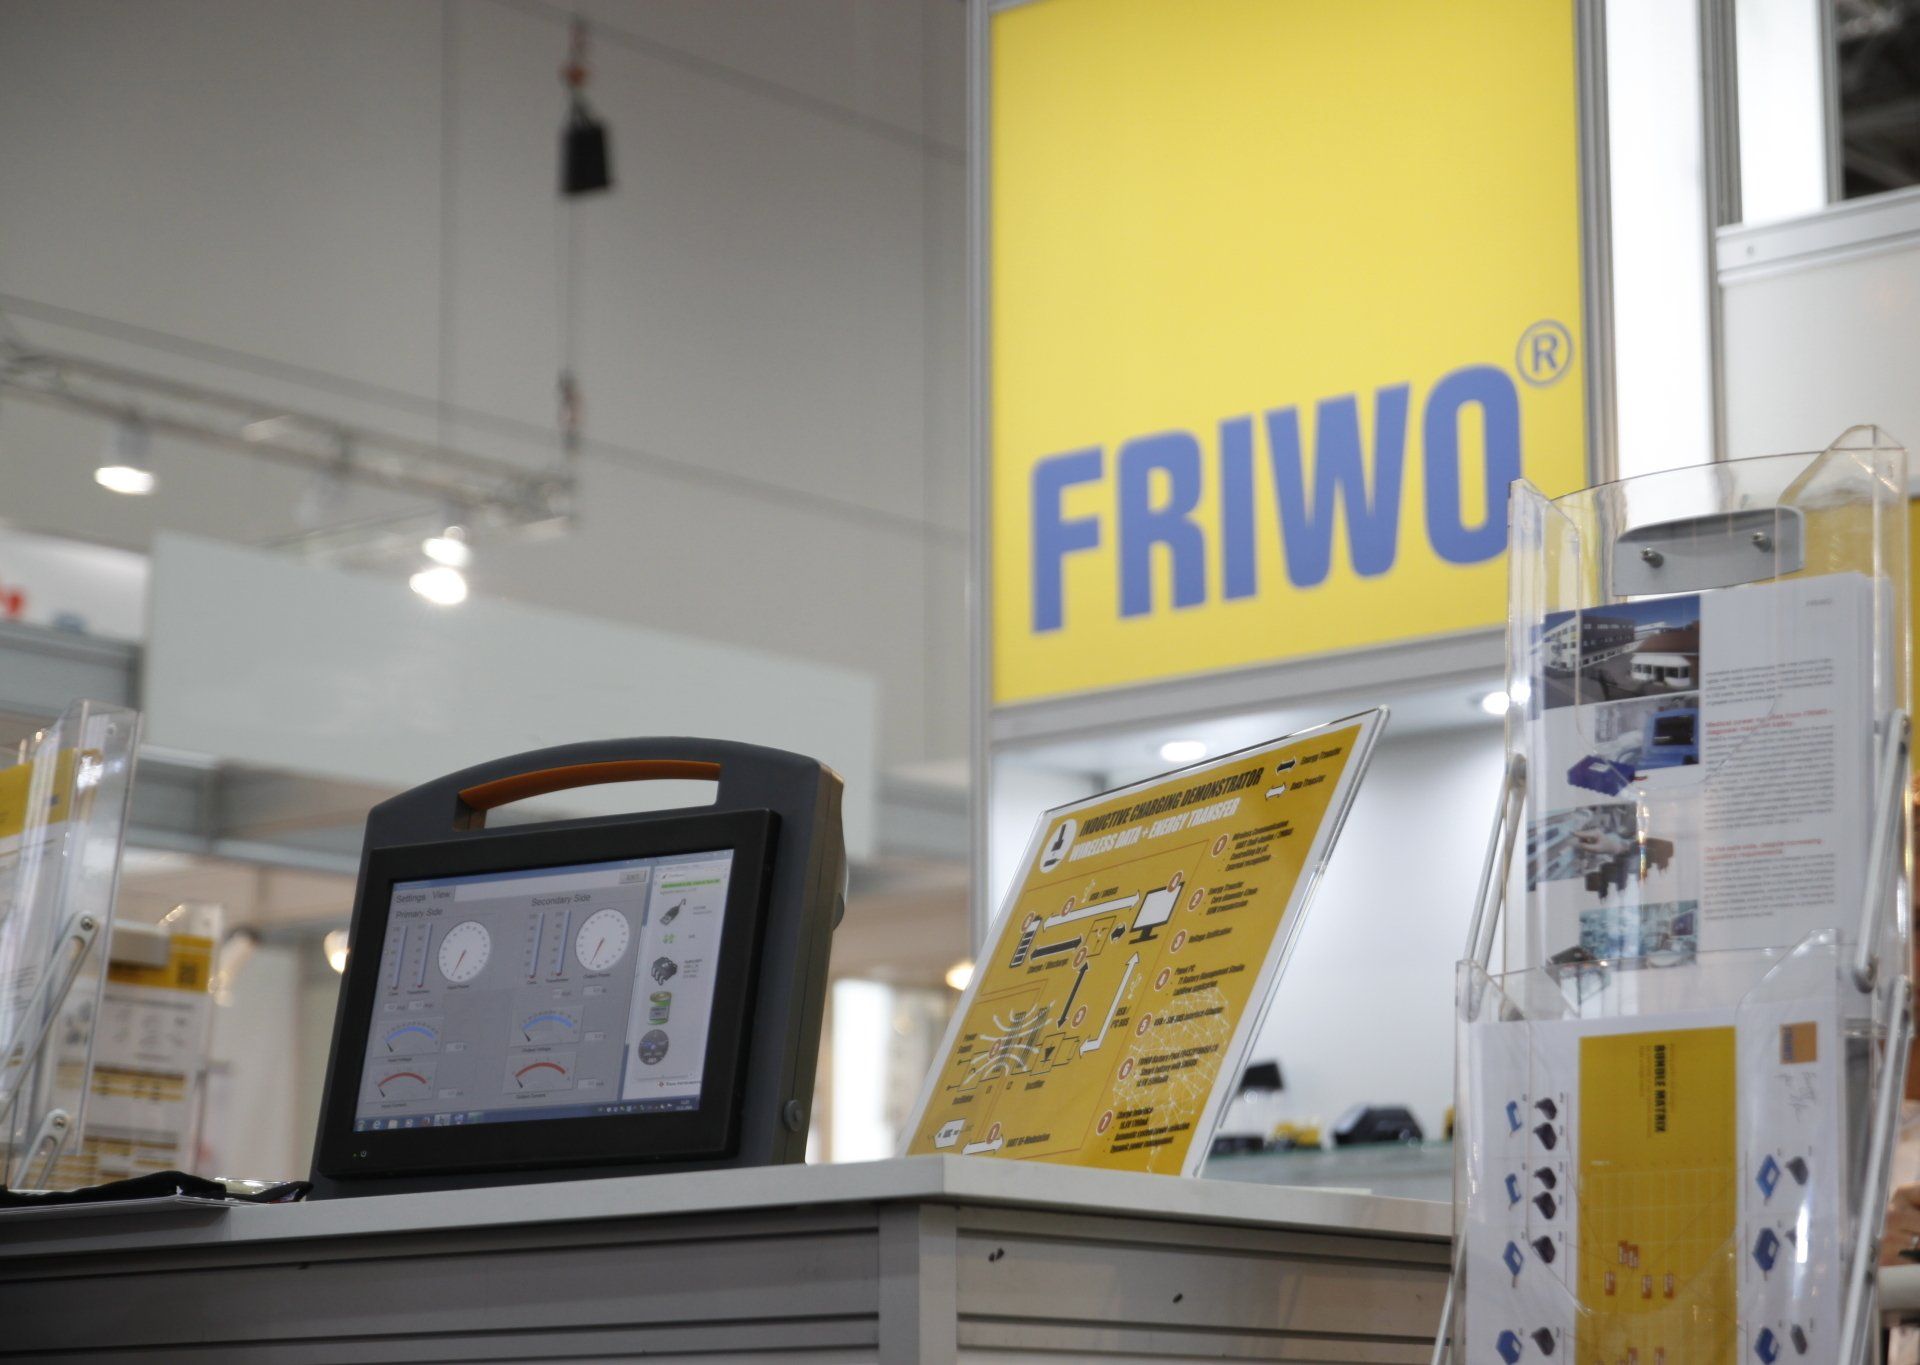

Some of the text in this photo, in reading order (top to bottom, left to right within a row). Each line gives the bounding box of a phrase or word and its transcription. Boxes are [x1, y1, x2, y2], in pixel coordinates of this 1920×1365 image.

[1079, 767, 1264, 838] INDUCTIVE CHARGING DEMONSTRATOR
[1069, 833, 1118, 862] WIRELESS
[1114, 826, 1142, 849] DATA
[1148, 812, 1190, 840] ENERGY
[1187, 796, 1241, 829] TRANSFER
[396, 890, 451, 903] Settings View
[396, 907, 443, 920] Primary Side
[531, 892, 591, 907] Secondary Side
[1654, 1044, 1666, 1133] BUNDLE MATRIX
